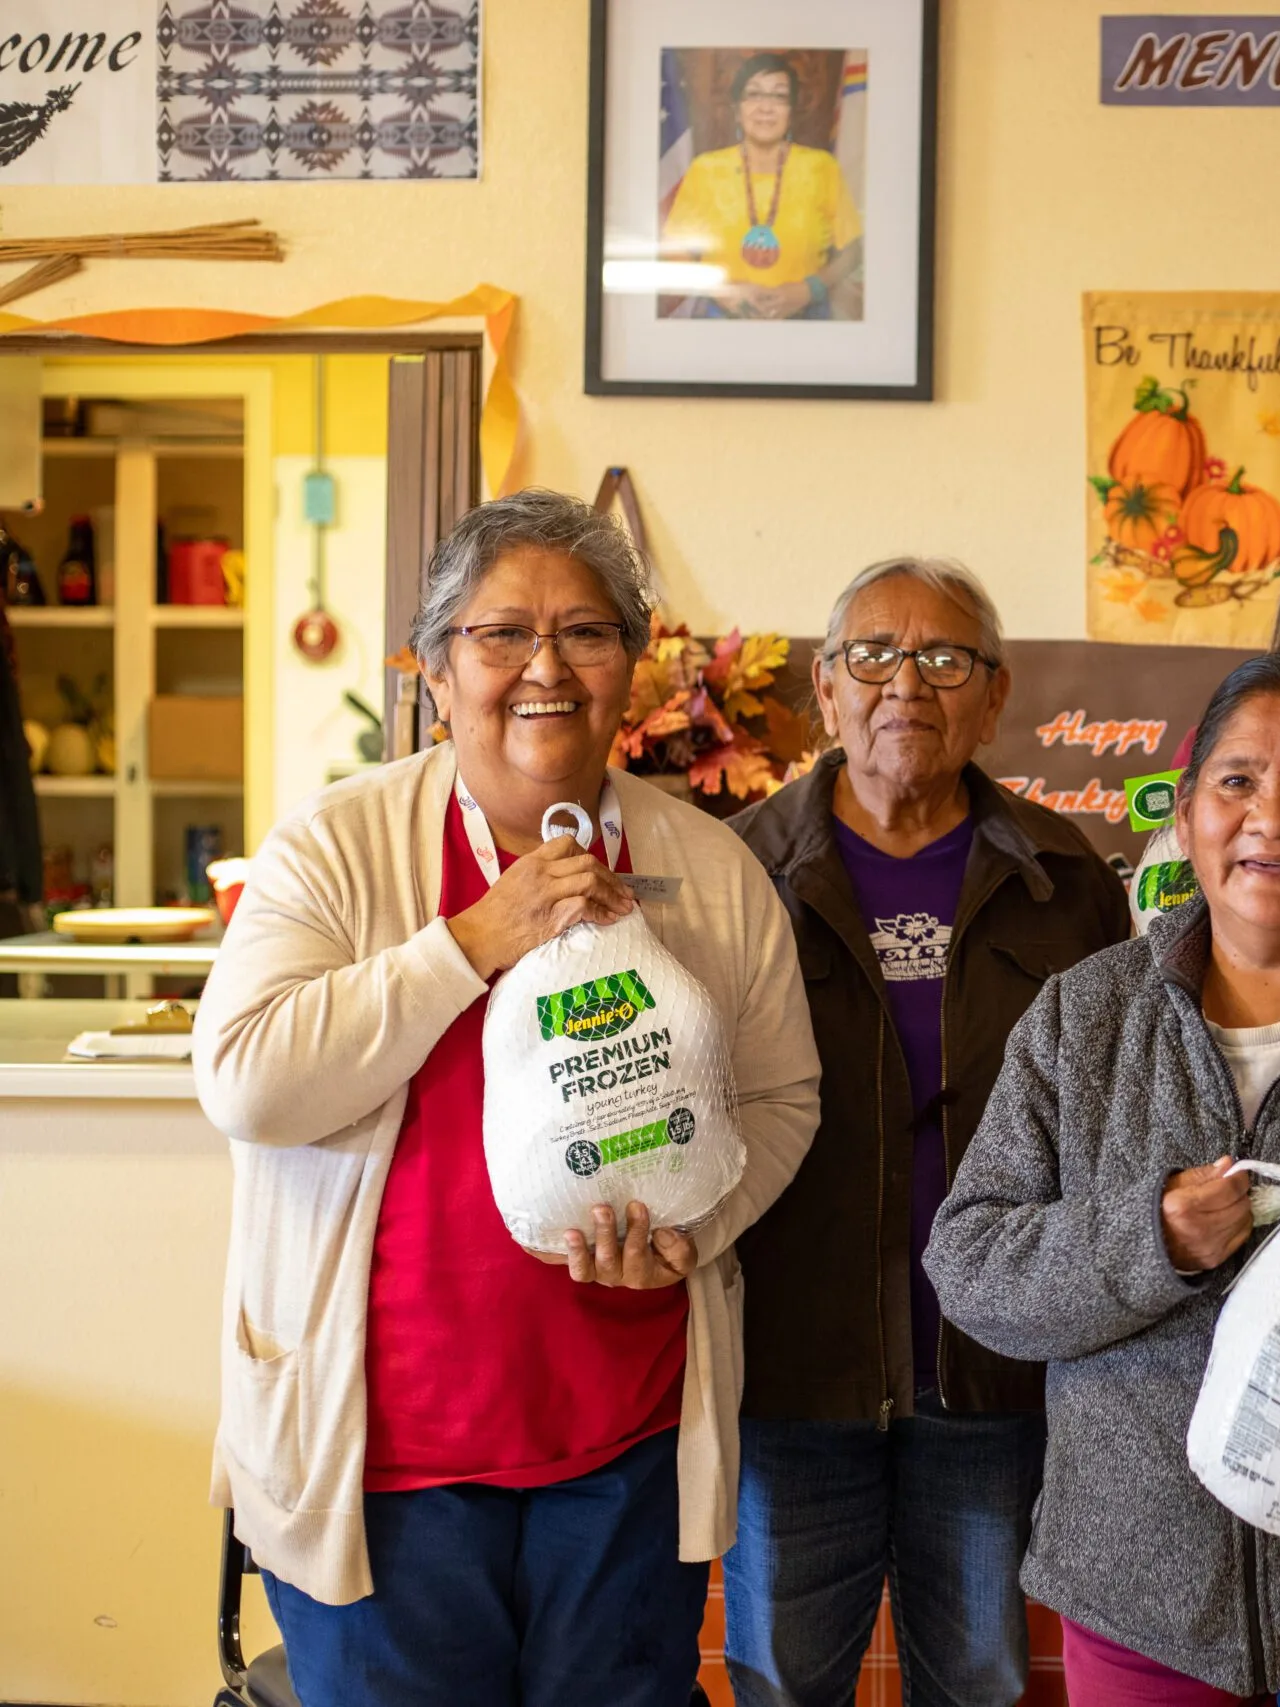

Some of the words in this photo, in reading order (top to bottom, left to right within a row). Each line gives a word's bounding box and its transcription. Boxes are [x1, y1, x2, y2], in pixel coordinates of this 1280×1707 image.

[1093, 325, 1141, 367] Be
[1036, 709, 1168, 757] Happy
[548, 1026, 673, 1085] PREMIUM
[560, 1050, 672, 1104] FROZEN
[586, 1095, 623, 1117] young
[623, 1082, 659, 1101] turkey
